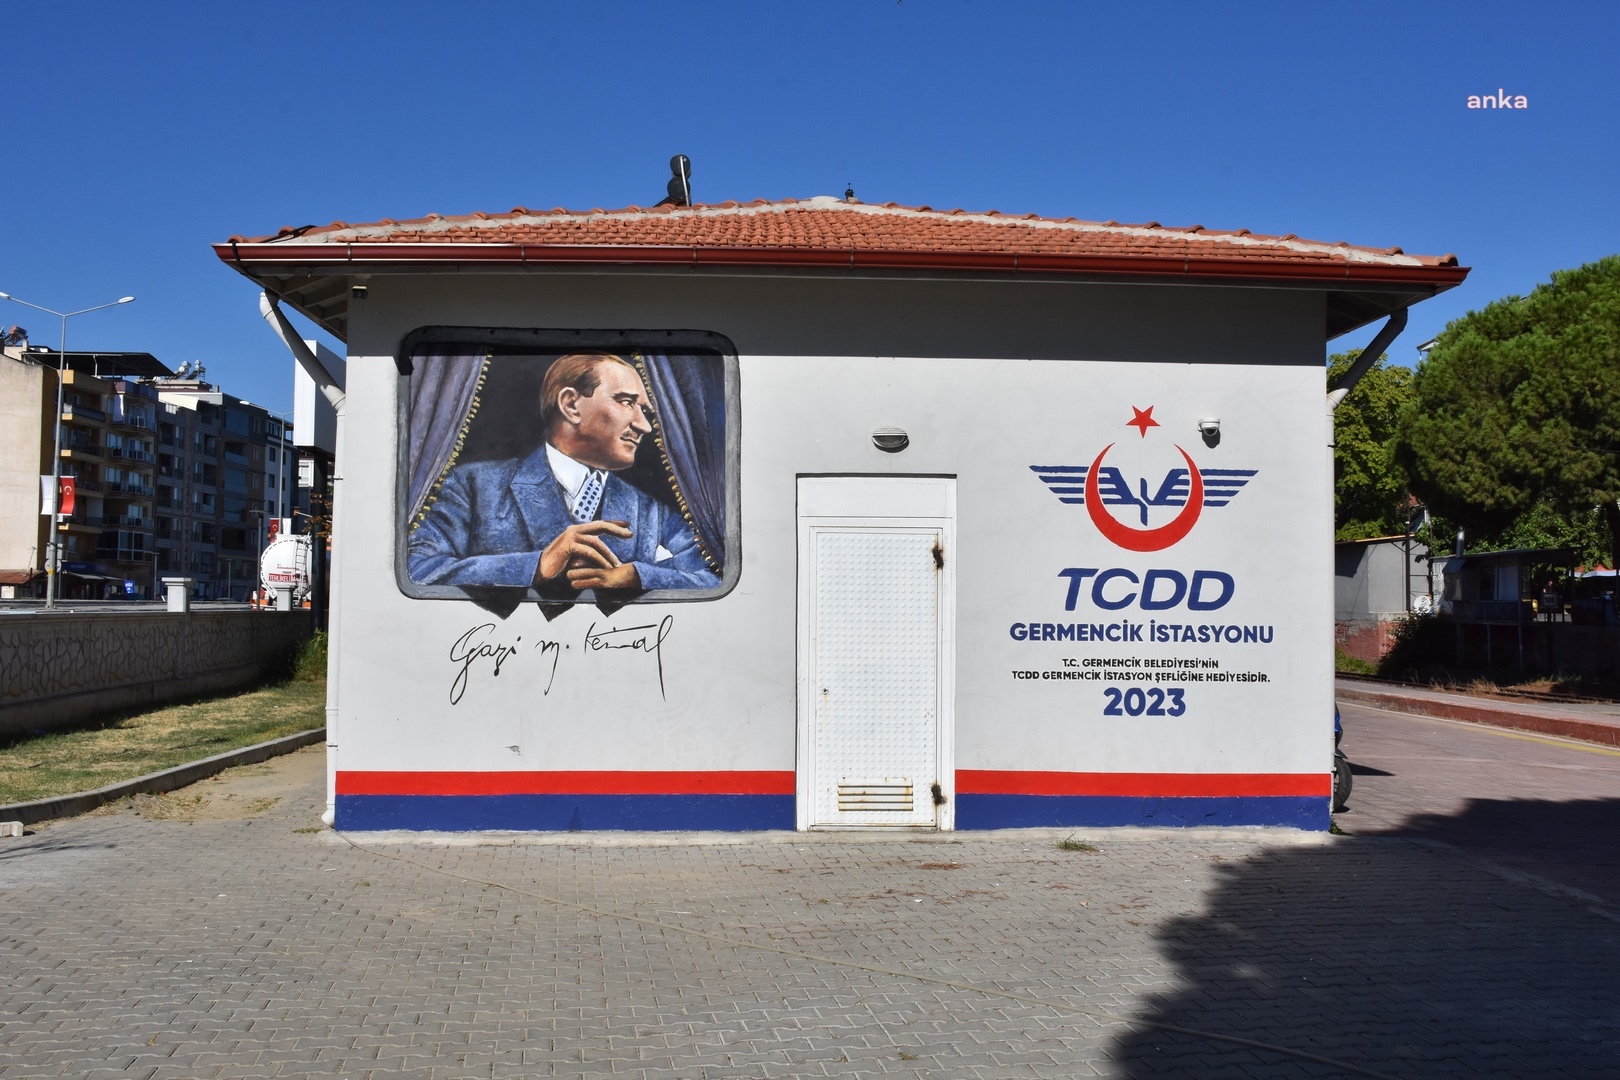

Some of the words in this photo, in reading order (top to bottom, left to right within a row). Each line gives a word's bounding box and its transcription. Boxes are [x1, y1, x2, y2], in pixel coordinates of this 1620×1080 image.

[1057, 567, 1235, 612] TCDD
[1009, 619, 1144, 642] GERMENCİK
[1149, 619, 1274, 644] İSTASYONU
[1062, 658, 1080, 668] T.C.
[1082, 656, 1141, 668] GERMENCİK
[1144, 657, 1219, 669] BELEDİYESİ'NİN
[1012, 670, 1040, 680] TCDD
[1042, 669, 1101, 681] GERMENCİK
[1103, 669, 1152, 681] İSTASYON
[1154, 670, 1204, 684] ŞEFLİĞİNE
[1206, 671, 1271, 683] HEDİYESİDİR.
[1103, 686, 1186, 718] 2023
